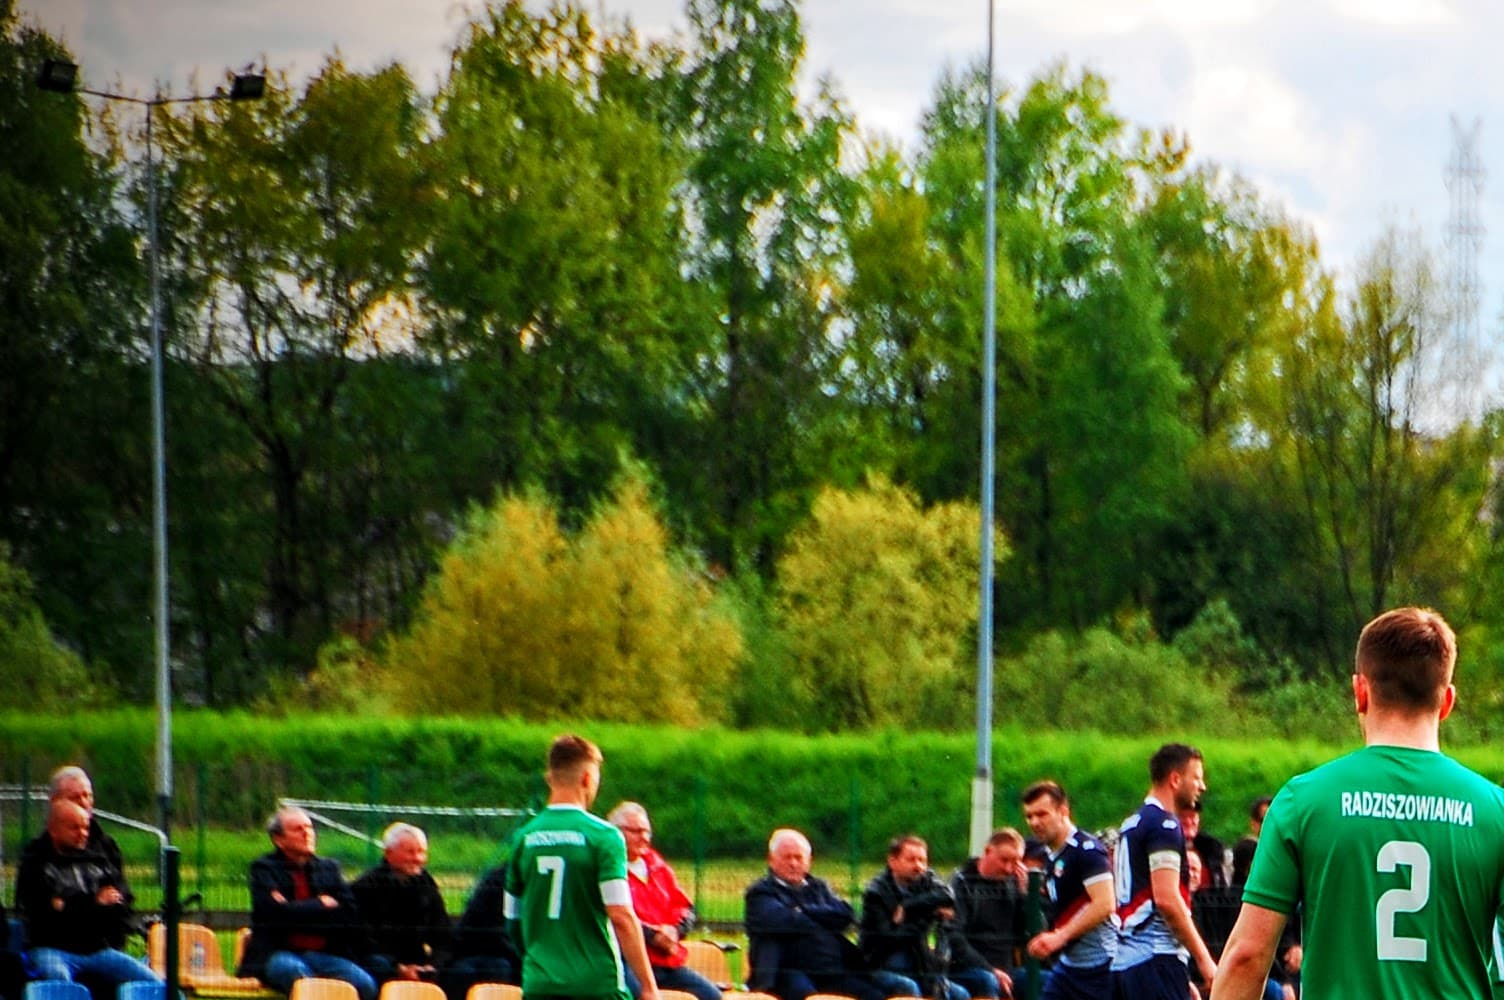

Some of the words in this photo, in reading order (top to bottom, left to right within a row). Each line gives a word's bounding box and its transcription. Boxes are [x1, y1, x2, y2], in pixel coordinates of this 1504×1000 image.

[1342, 791, 1473, 827] RADZISZOWIANKA
[536, 856, 566, 919] 7
[1376, 840, 1431, 962] 2
